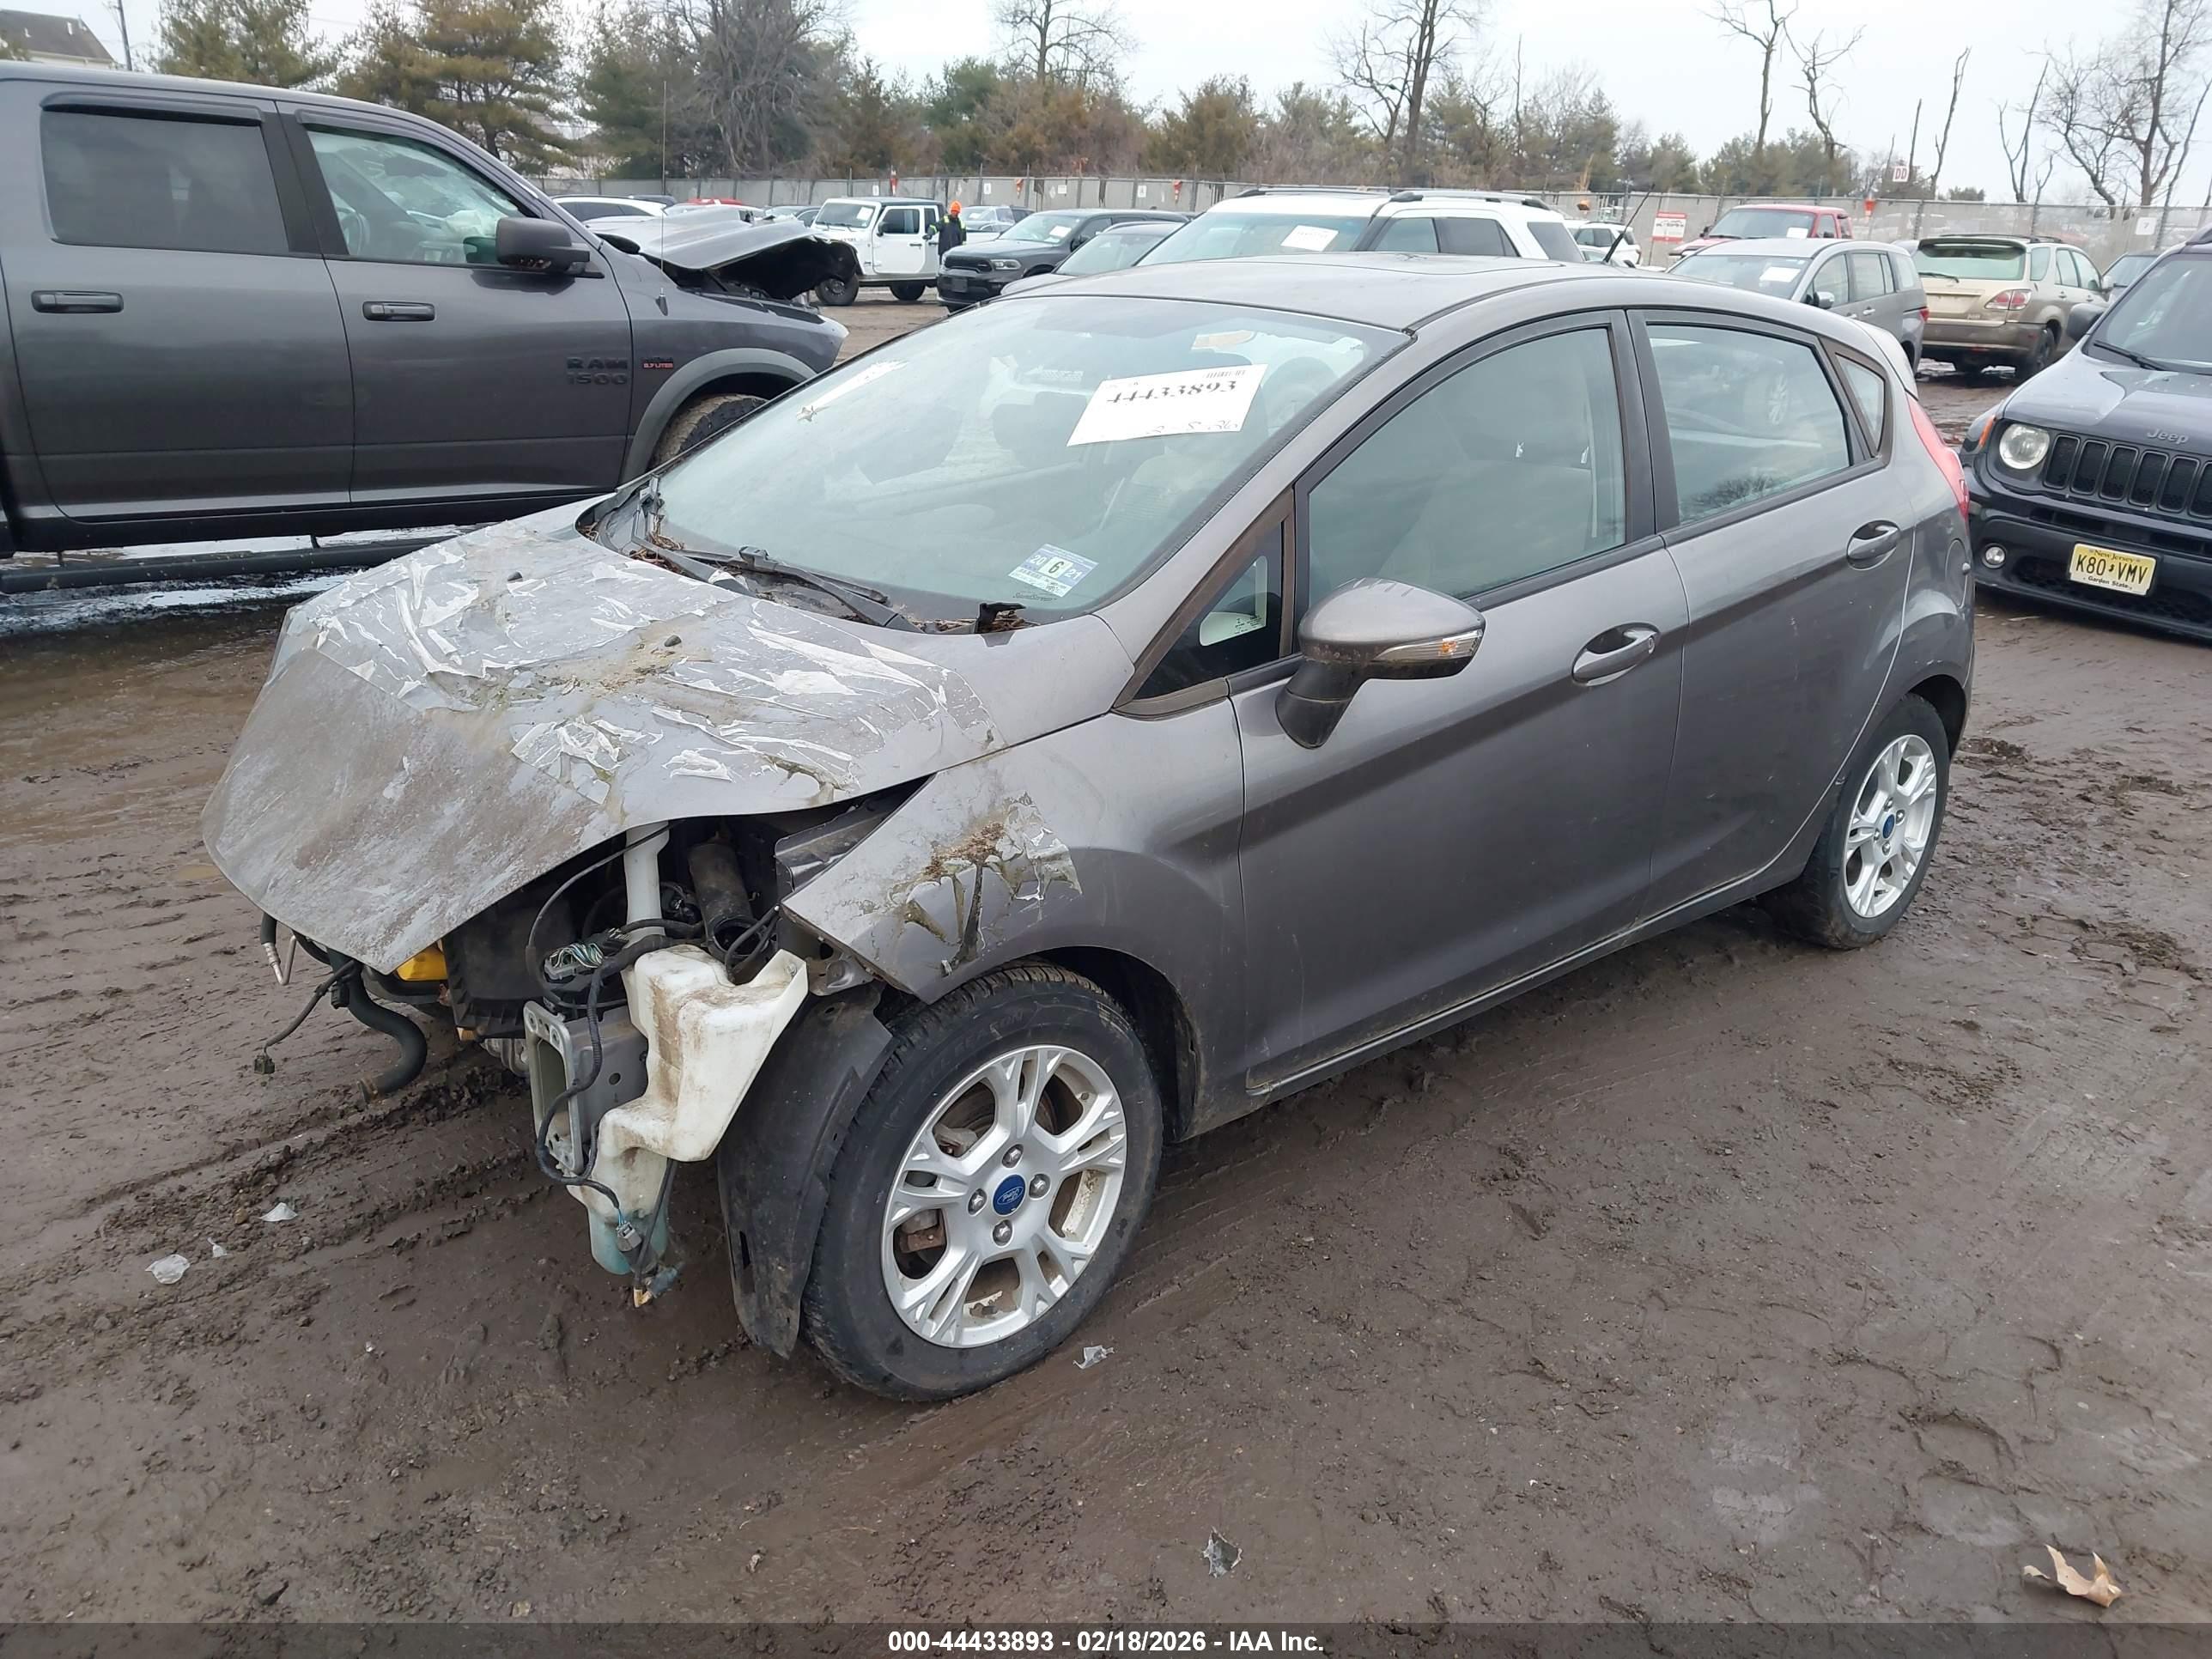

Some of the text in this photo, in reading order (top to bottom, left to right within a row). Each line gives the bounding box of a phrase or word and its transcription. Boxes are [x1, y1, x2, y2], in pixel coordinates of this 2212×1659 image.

[567, 356, 628, 369] RAM
[567, 371, 628, 385] 1500
[1107, 380, 1237, 404] 44433893
[2147, 428, 2189, 445] Jeep
[2094, 550, 2134, 562] New Jersey
[1030, 555, 1083, 580] 20 6 21
[2075, 554, 2148, 585] K80 VMV
[2088, 575, 2129, 588] Garden State
